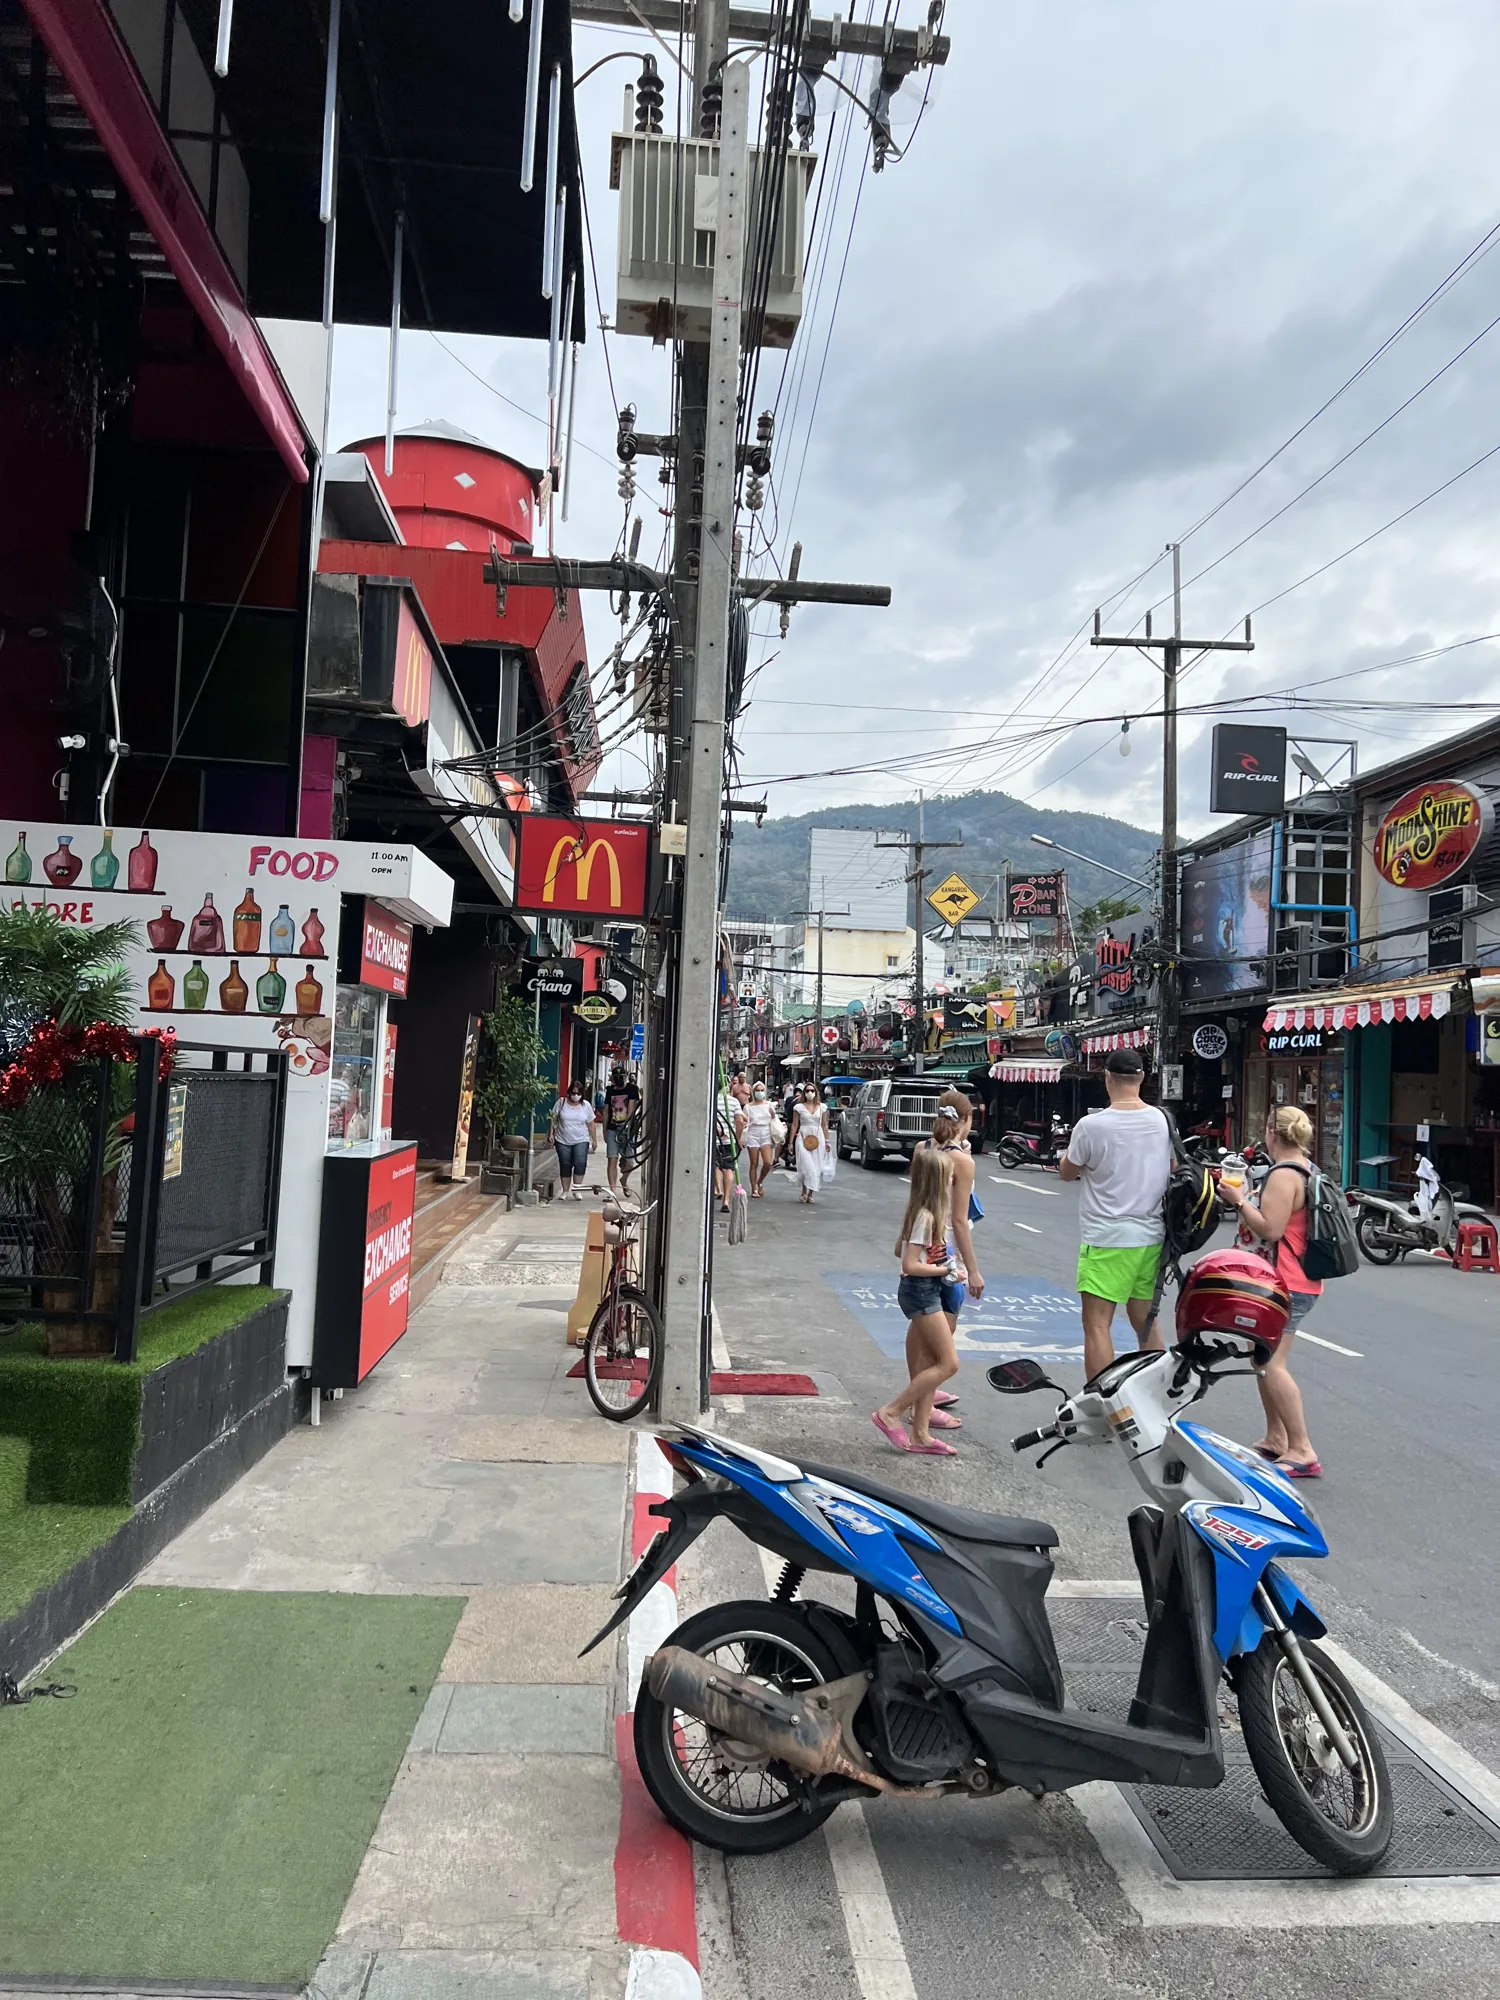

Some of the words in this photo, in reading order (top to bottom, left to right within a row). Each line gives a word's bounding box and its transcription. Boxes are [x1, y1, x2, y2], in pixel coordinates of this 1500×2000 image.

[1223, 772, 1246, 780] RIP
[1246, 774, 1279, 783] CURL
[248, 846, 339, 882] FOOD
[1432, 850, 1464, 869] Bar
[1037, 889, 1056, 900] BAR
[365, 923, 408, 973] EXCHANGE
[527, 978, 573, 996] Chang
[1268, 1036, 1290, 1049] RIP
[1290, 1034, 1323, 1048] CURL
[367, 1201, 393, 1231] CURRENCY
[364, 1216, 412, 1288] EXCHANGE
[389, 1272, 408, 1305] SERVICE
[1203, 1517, 1270, 1549] 125i
